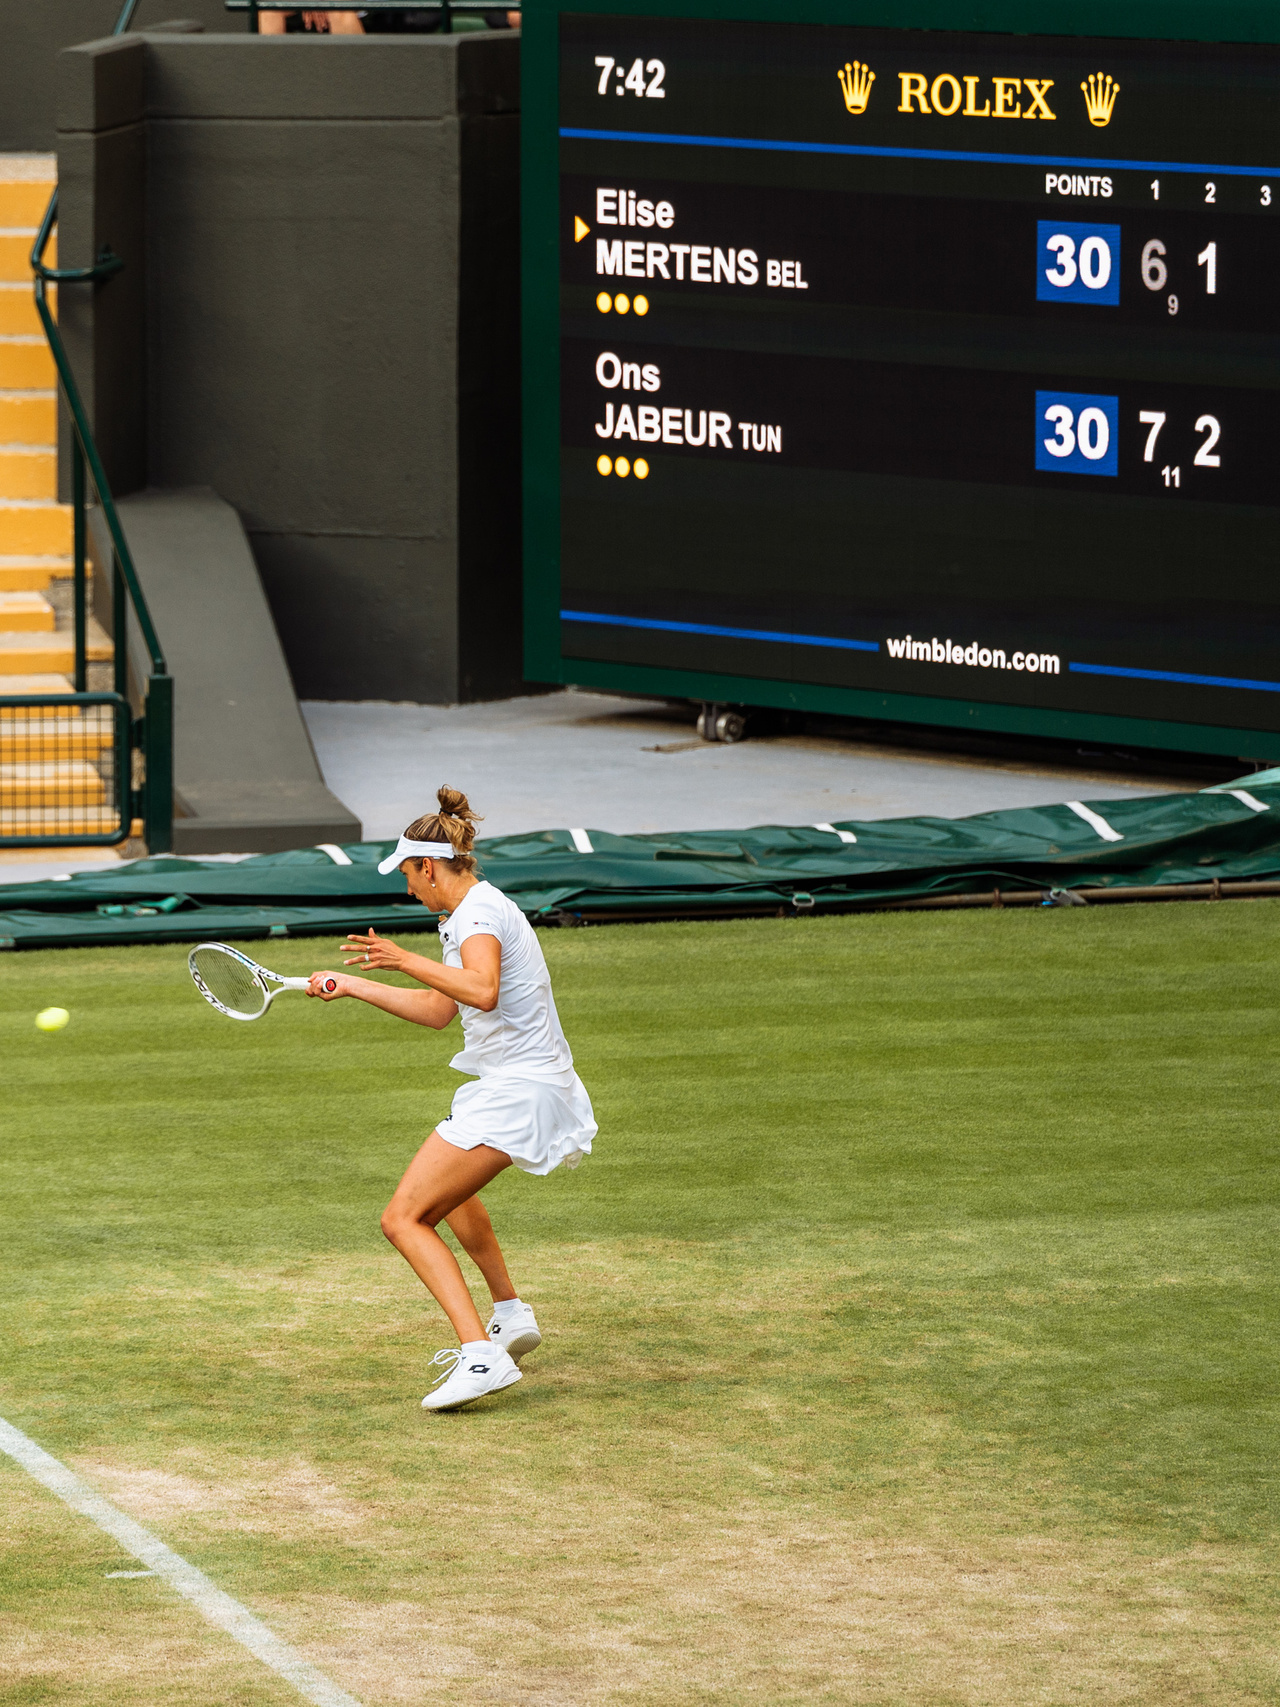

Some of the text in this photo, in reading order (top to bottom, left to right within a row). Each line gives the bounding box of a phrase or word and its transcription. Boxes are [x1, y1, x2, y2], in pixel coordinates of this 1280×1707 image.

[594, 56, 666, 99] 7:42
[896, 71, 1057, 121] ROLEX
[596, 187, 675, 229] Elise
[1045, 173, 1272, 206] POINTS 1 2 3
[596, 238, 809, 289] MERTENS BEL
[1045, 233, 1217, 295] 30 6 1
[1167, 294, 1179, 316] 9
[595, 351, 661, 392] Ons
[595, 402, 782, 453] JABEUR TUN
[1043, 404, 1221, 468] 30 7 2
[1161, 465, 1180, 488] 11
[886, 634, 1061, 675] wimbledon.com
